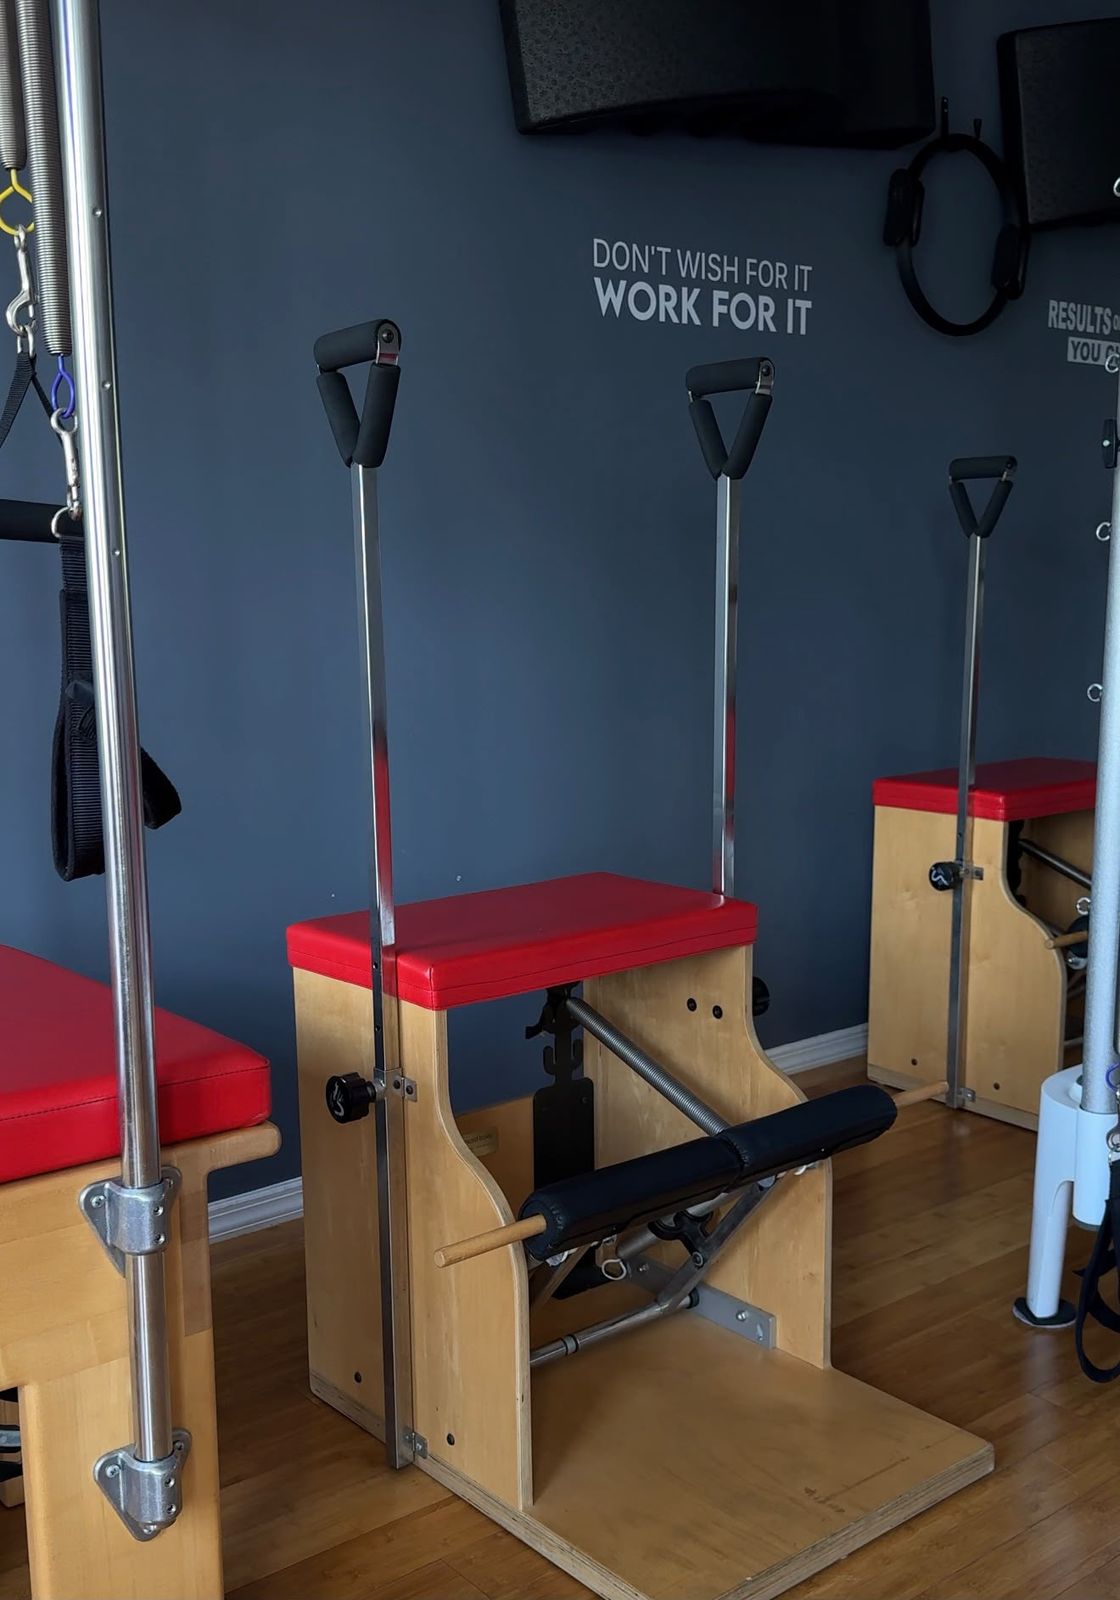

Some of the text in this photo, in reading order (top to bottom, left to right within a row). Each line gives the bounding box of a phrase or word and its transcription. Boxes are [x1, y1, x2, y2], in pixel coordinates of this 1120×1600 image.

[593, 238, 812, 292] DON'T WISH FOR IT
[594, 277, 812, 335] WORK FOR IT
[1048, 300, 1112, 335] RESULTS
[1071, 340, 1101, 362] YOU
